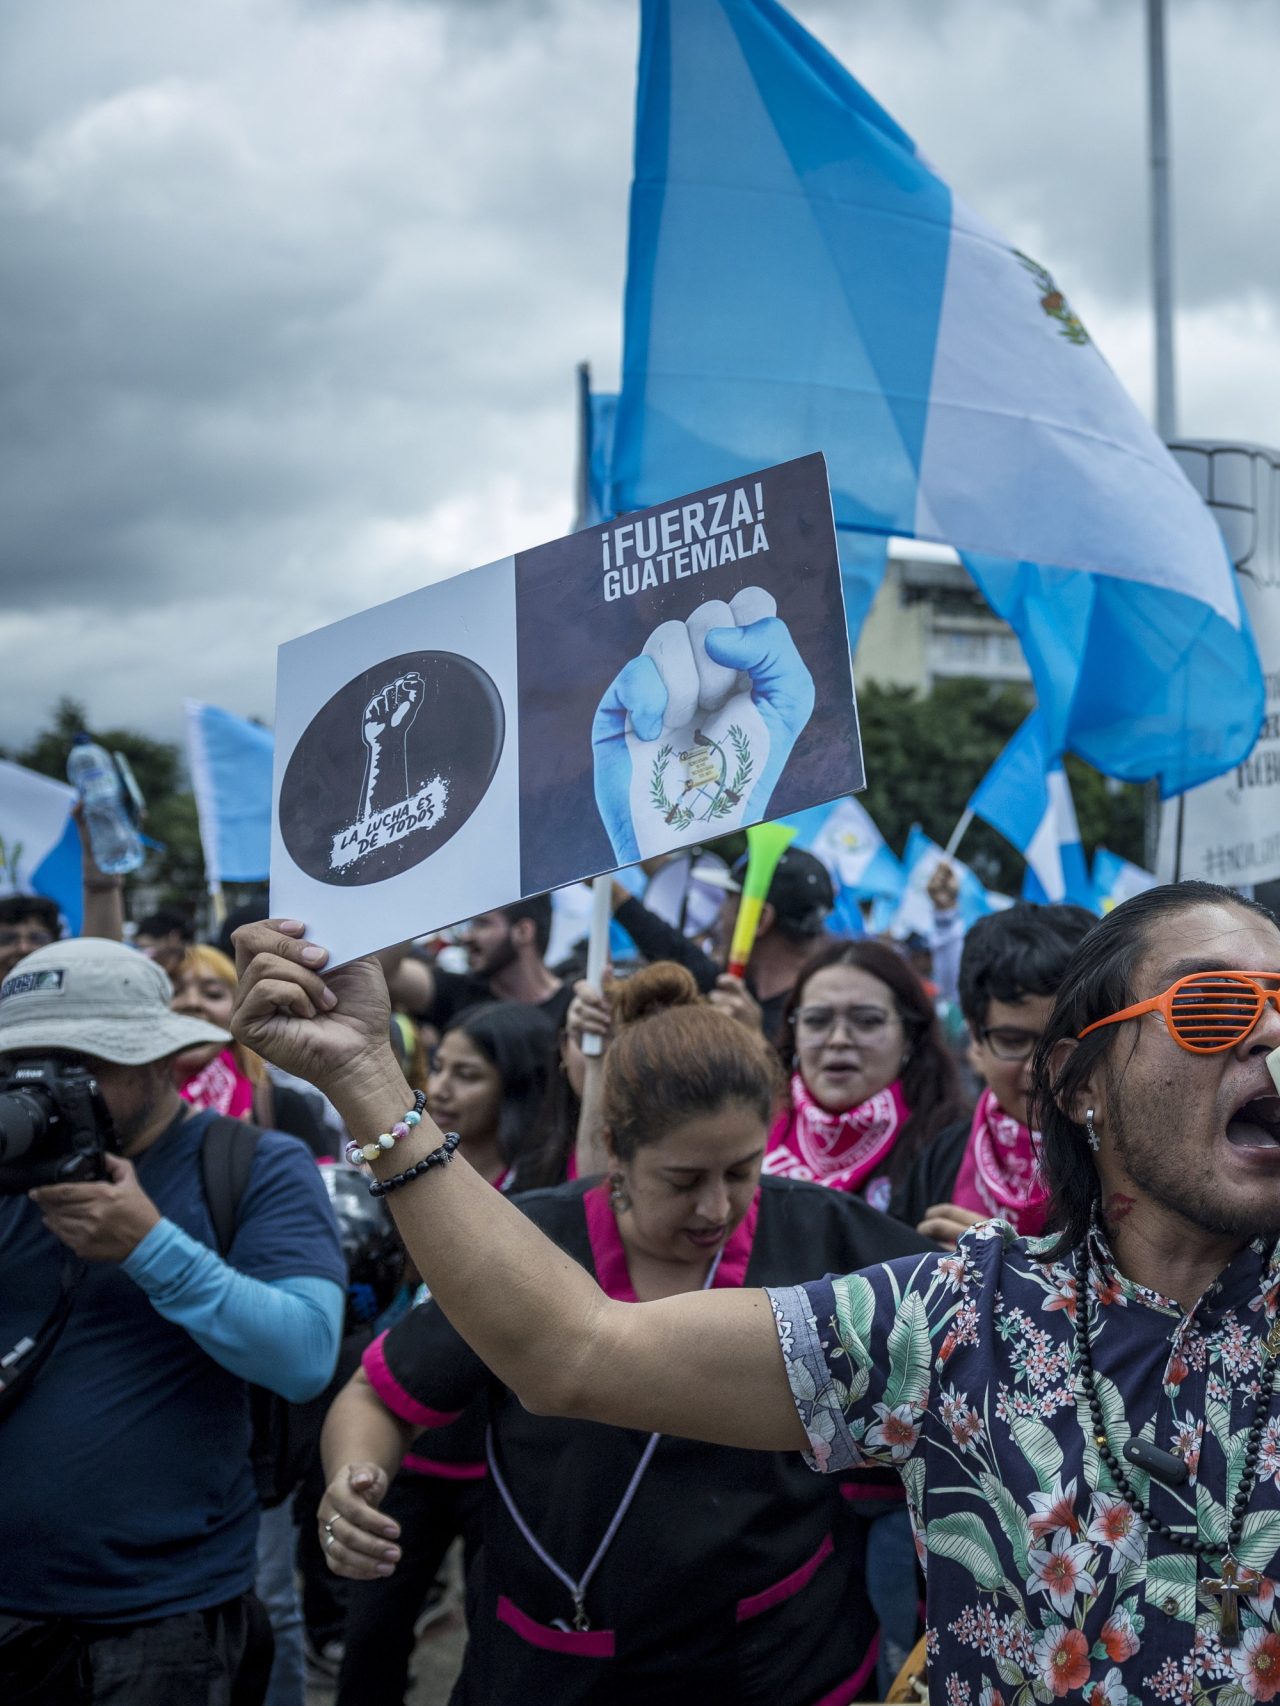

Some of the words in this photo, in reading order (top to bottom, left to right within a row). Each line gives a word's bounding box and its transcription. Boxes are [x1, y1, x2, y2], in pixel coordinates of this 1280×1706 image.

[602, 482, 765, 571] ¡FUERZA!
[603, 523, 770, 602] GUATEMALA
[340, 829, 358, 850] LA
[366, 803, 410, 838] LUCHA
[416, 793, 433, 811] ES
[357, 832, 379, 855] DE
[386, 804, 435, 838] TODOS
